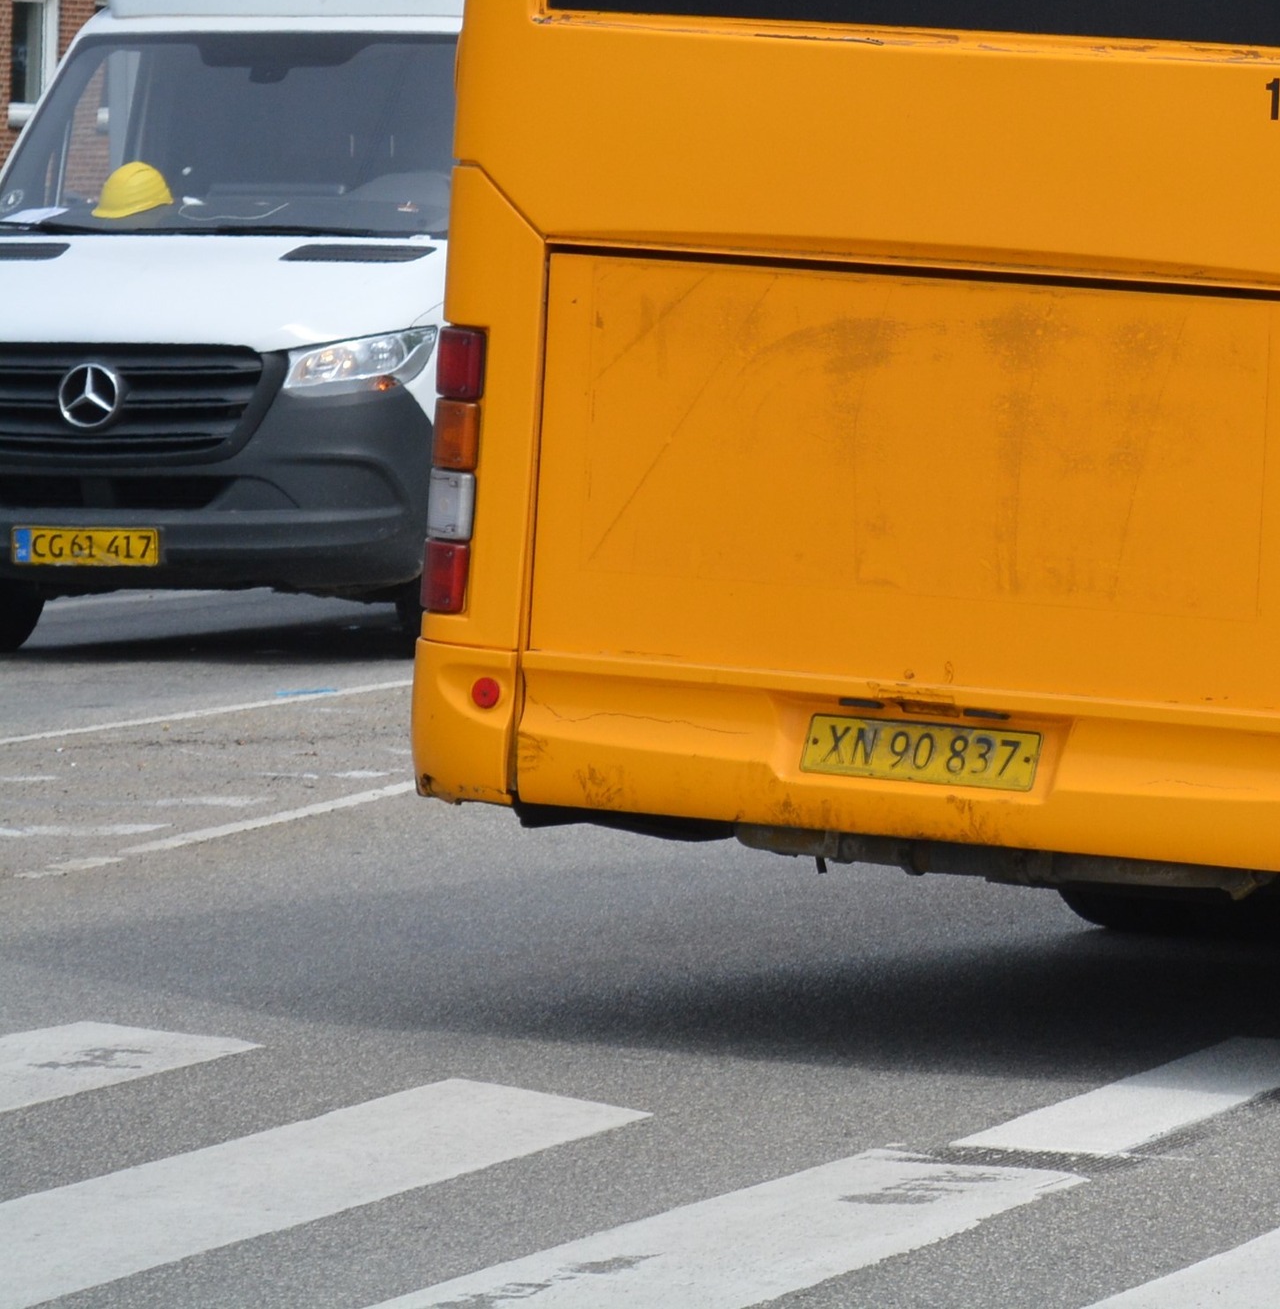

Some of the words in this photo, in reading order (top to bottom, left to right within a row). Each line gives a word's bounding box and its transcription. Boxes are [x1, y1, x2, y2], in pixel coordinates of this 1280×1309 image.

[32, 534, 64, 559] CG
[70, 534, 97, 559] 61
[106, 535, 152, 559] 417
[820, 724, 878, 766] XN
[889, 731, 936, 771] 90
[945, 734, 1022, 778] 837
